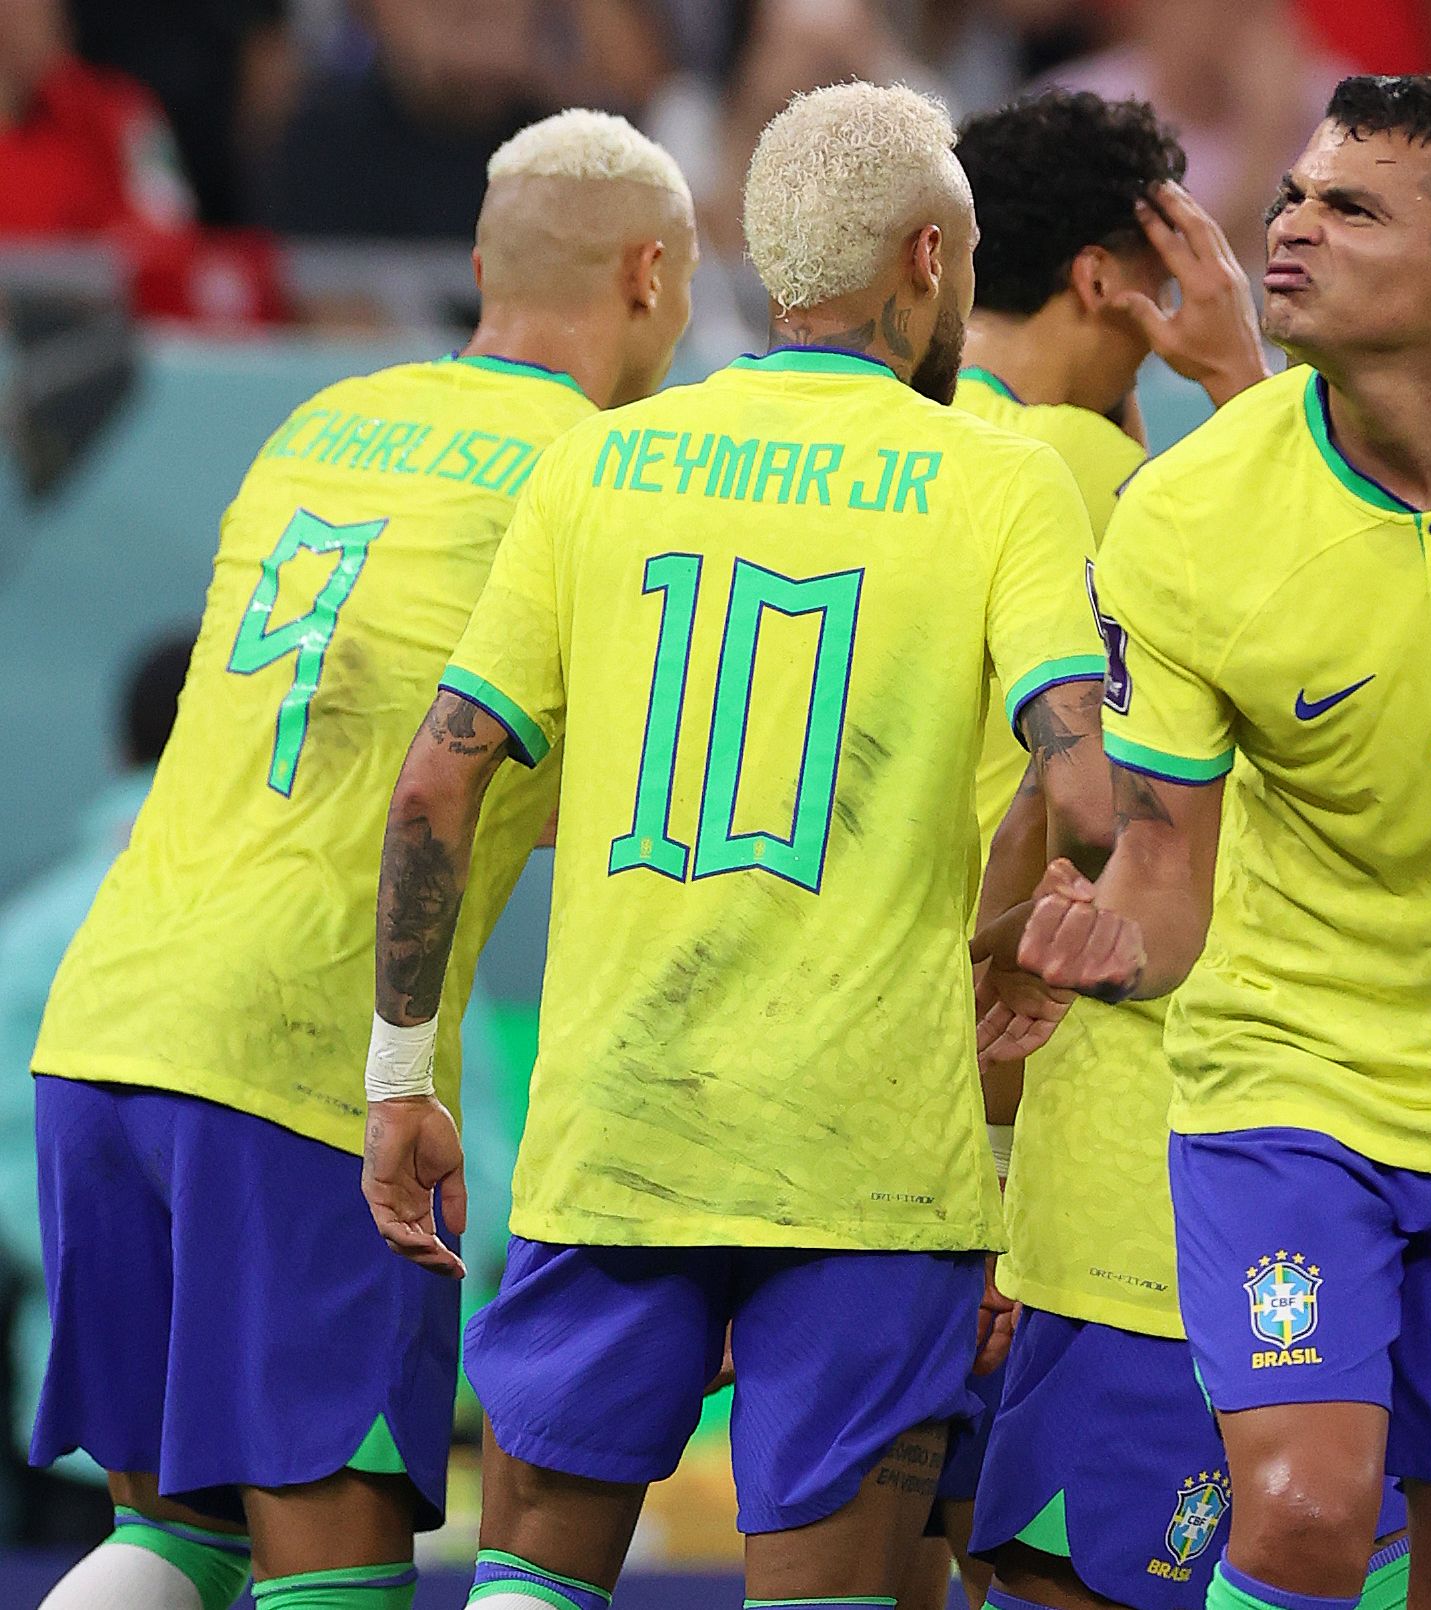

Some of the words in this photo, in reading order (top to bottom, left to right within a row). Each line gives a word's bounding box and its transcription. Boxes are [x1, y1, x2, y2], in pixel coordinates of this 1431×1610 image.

[592, 429, 845, 505] NEYMAR
[848, 449, 943, 514] JR
[226, 507, 389, 799] 9
[608, 551, 866, 895] 10
[1271, 1296, 1297, 1308] CBF
[1251, 1347, 1324, 1370] BRASIL
[1187, 1514, 1207, 1527] CBF
